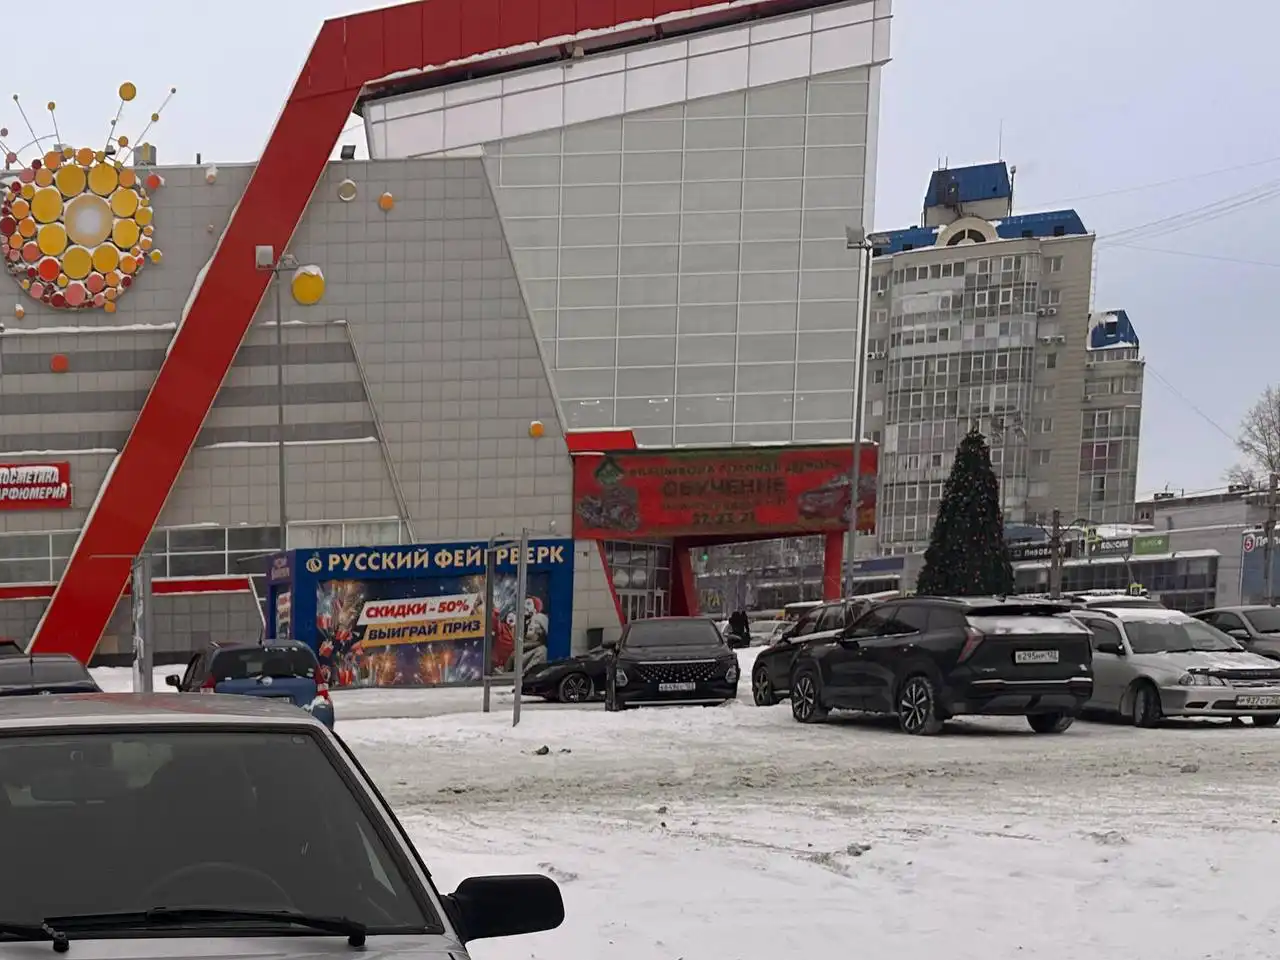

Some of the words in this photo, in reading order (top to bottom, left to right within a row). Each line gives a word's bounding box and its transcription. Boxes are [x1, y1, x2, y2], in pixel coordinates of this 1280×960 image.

[328, 548, 429, 572] РУССКИЙ
[434, 545, 564, 568] ФЕЙРВЕРК
[365, 603, 426, 619] СКИДКИ
[368, 623, 438, 641] ВЫИГРАЙ
[442, 619, 481, 635] ПРИЗ
